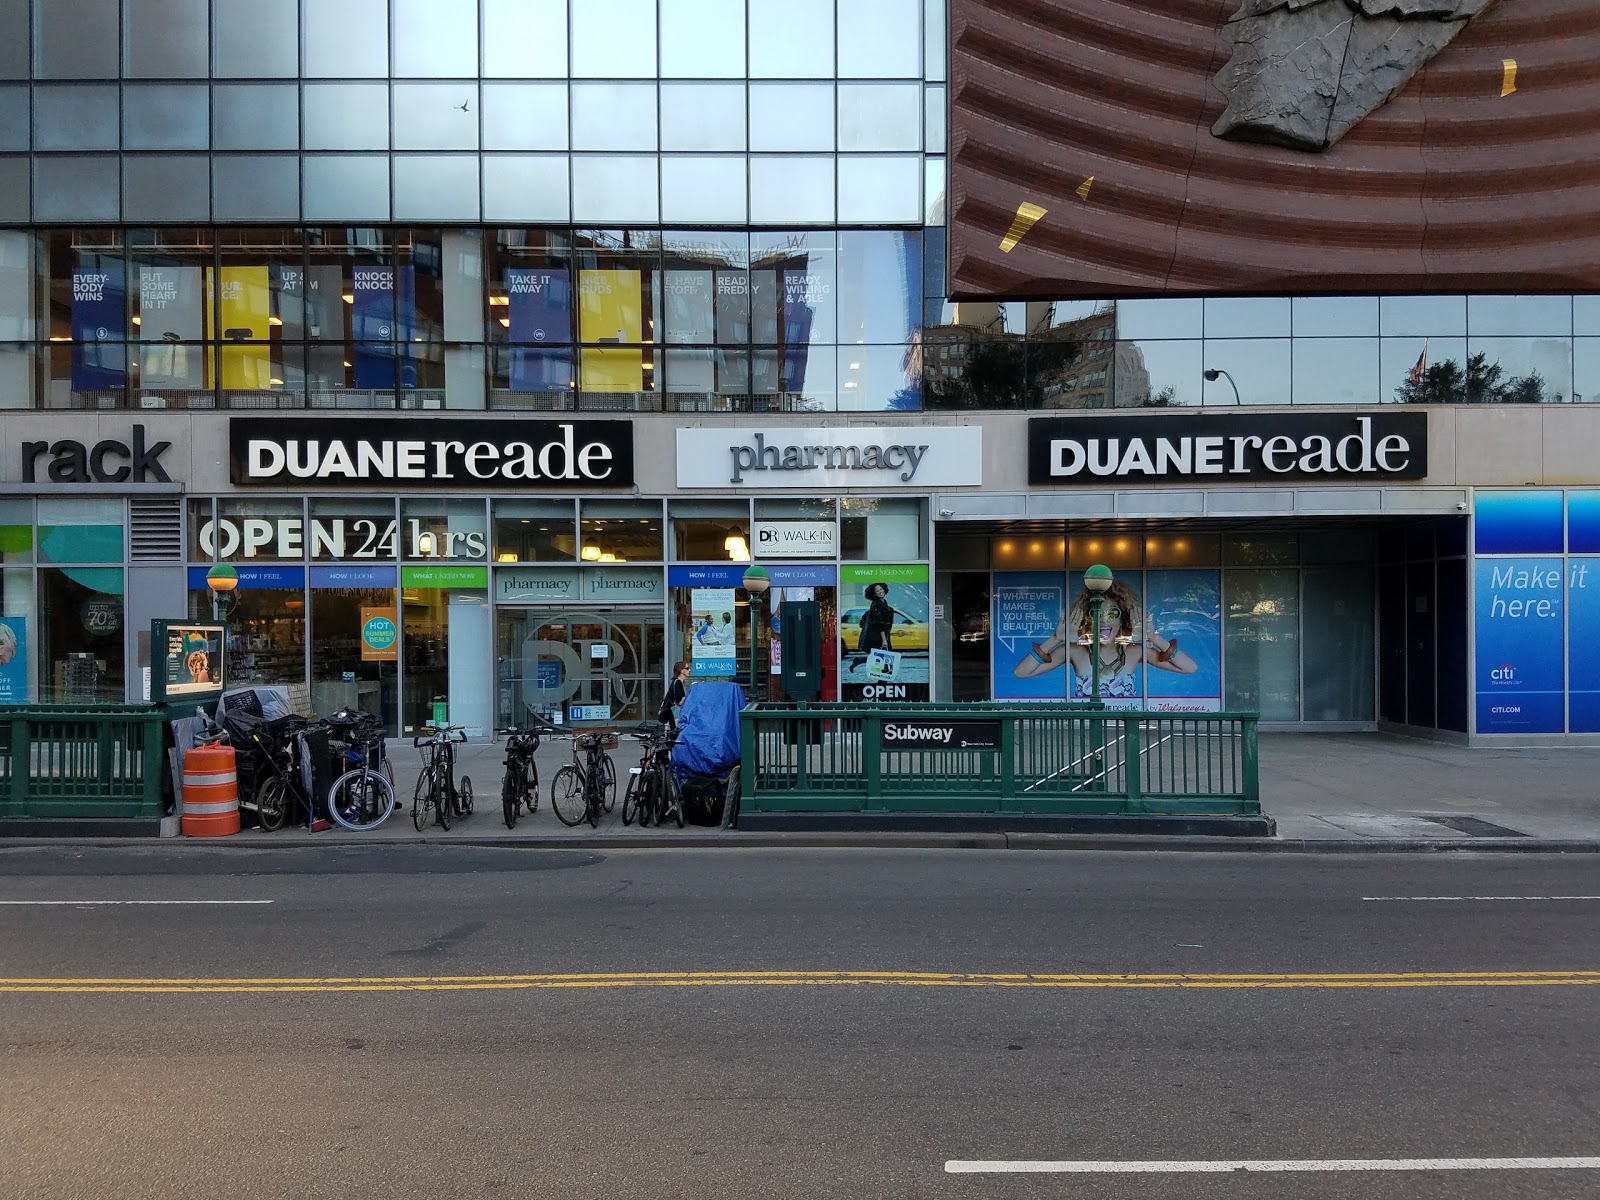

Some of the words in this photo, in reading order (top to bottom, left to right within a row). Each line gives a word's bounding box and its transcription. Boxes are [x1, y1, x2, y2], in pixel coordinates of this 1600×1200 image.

[73, 274, 109, 283] EVERY-
[141, 273, 162, 281] PUT
[282, 272, 297, 281] UP
[354, 272, 393, 280] KNOCK
[510, 275, 537, 285] TAKE
[541, 275, 550, 284] IT
[582, 276, 607, 285] NICE
[208, 281, 243, 290] YUR.
[283, 281, 297, 290] AT
[354, 281, 393, 290] KNOCK
[675, 277, 703, 285] HAVE
[785, 276, 821, 286] READY,
[73, 283, 104, 292] BODY
[141, 282, 174, 291] SOME
[510, 285, 542, 293] AWAY
[582, 285, 612, 294] DUDS
[786, 286, 829, 294] WILLING
[74, 292, 103, 301] WINS
[141, 291, 177, 300] HEART
[208, 291, 238, 300] FCE.
[785, 295, 795, 303] &
[798, 295, 823, 303] ABLE
[141, 300, 153, 309] IN
[158, 300, 167, 309] IT
[21, 424, 172, 483] rack
[730, 433, 929, 483] pharmacy
[200, 519, 345, 559] OPEN
[353, 519, 398, 558] 24
[408, 519, 487, 558] hrs
[783, 530, 832, 541] WALK-IN
[1491, 565, 1560, 589] Make
[1570, 564, 1588, 589] it
[504, 577, 571, 593] pharmacy
[591, 576, 658, 593] pharmacy
[1003, 592, 1055, 600] WHATEVER
[1003, 602, 1036, 611] MAKES
[1490, 594, 1556, 618] here.
[1003, 612, 1022, 621] YOU
[1025, 612, 1049, 620] FEEL
[109, 618, 118, 626] off
[1003, 622, 1056, 631] BEAUTIFUL
[1490, 666, 1514, 680] citi
[863, 685, 906, 698] OPEN
[1158, 703, 1206, 711] Walgreens
[884, 724, 953, 743] Subway
